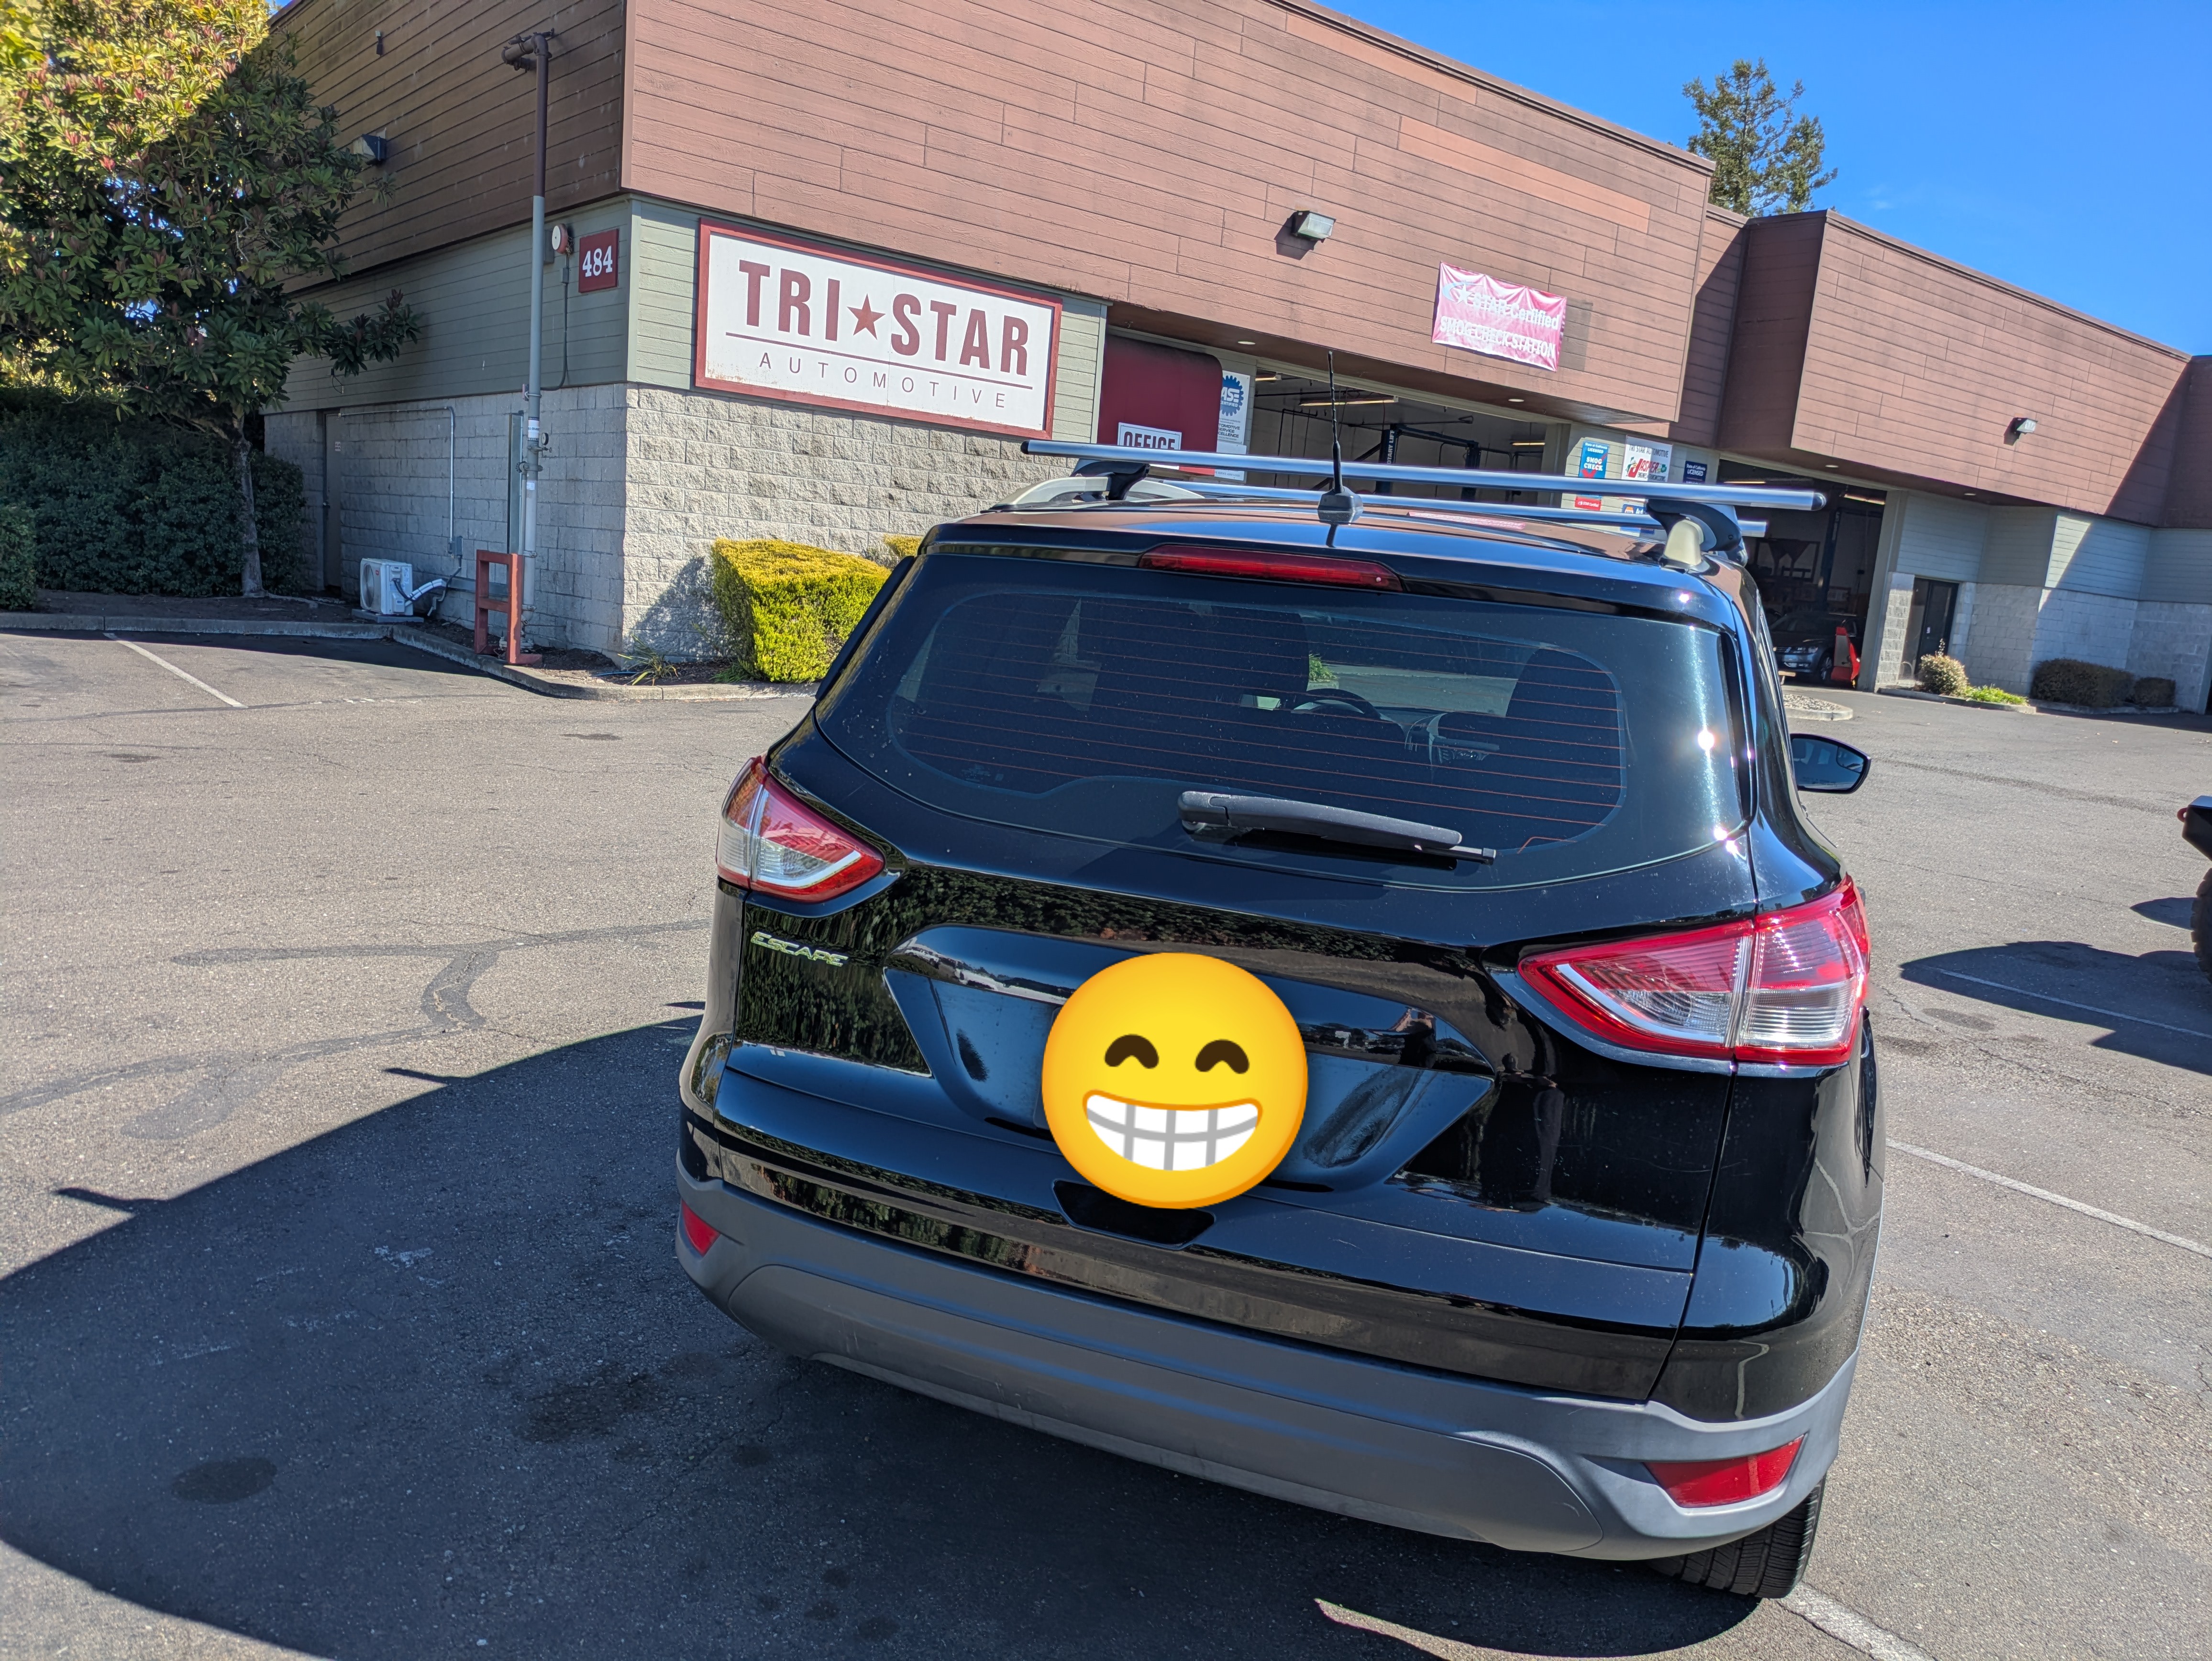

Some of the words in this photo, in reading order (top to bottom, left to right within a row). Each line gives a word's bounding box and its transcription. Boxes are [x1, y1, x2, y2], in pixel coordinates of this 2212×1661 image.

[582, 245, 613, 277] 484
[739, 259, 840, 342] TRI
[891, 293, 1029, 376] STAR
[1473, 292, 1507, 315] STAR
[1510, 302, 1560, 331] Certified
[1439, 315, 1472, 335] SMOG
[1476, 324, 1510, 346] CHECK
[1511, 334, 1556, 359] STATION
[759, 352, 1005, 408] AUTOMOTIVE
[1221, 387, 1240, 403] ASE
[1123, 431, 1176, 450] OFFICE
[1586, 456, 1603, 465] SMOG
[1646, 447, 1669, 458] AUTOMOTIVE
[1583, 463, 1603, 471] CHECK
[1627, 458, 1659, 478] JASPER
[1687, 468, 1703, 476] LICENSED
[750, 931, 849, 967] ESCAPE
